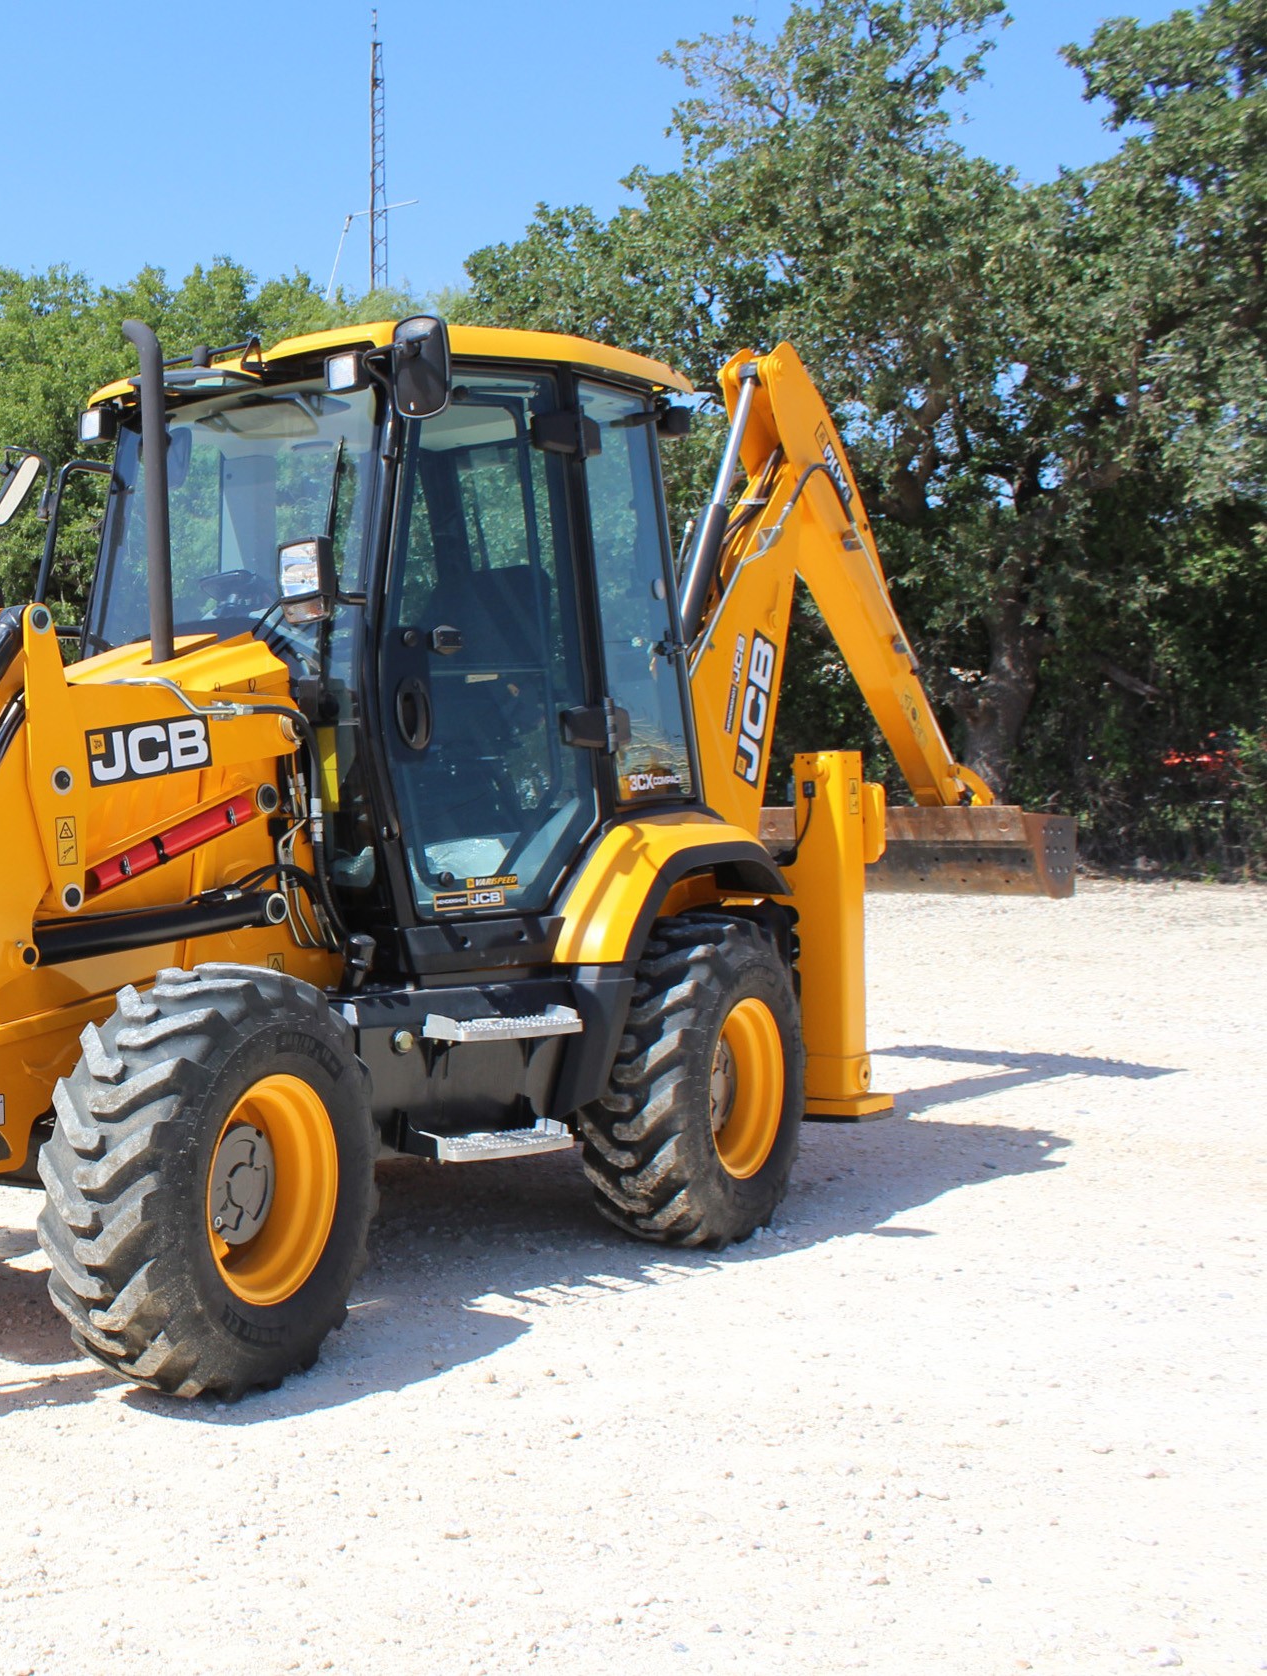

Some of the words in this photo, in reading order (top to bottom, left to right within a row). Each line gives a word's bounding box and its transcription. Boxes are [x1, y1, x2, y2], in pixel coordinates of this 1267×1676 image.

[733, 634, 746, 683] JCB
[738, 637, 775, 782] JCB
[92, 719, 209, 781] JCB
[628, 774, 654, 791] 3CX
[470, 891, 501, 904] JCB
